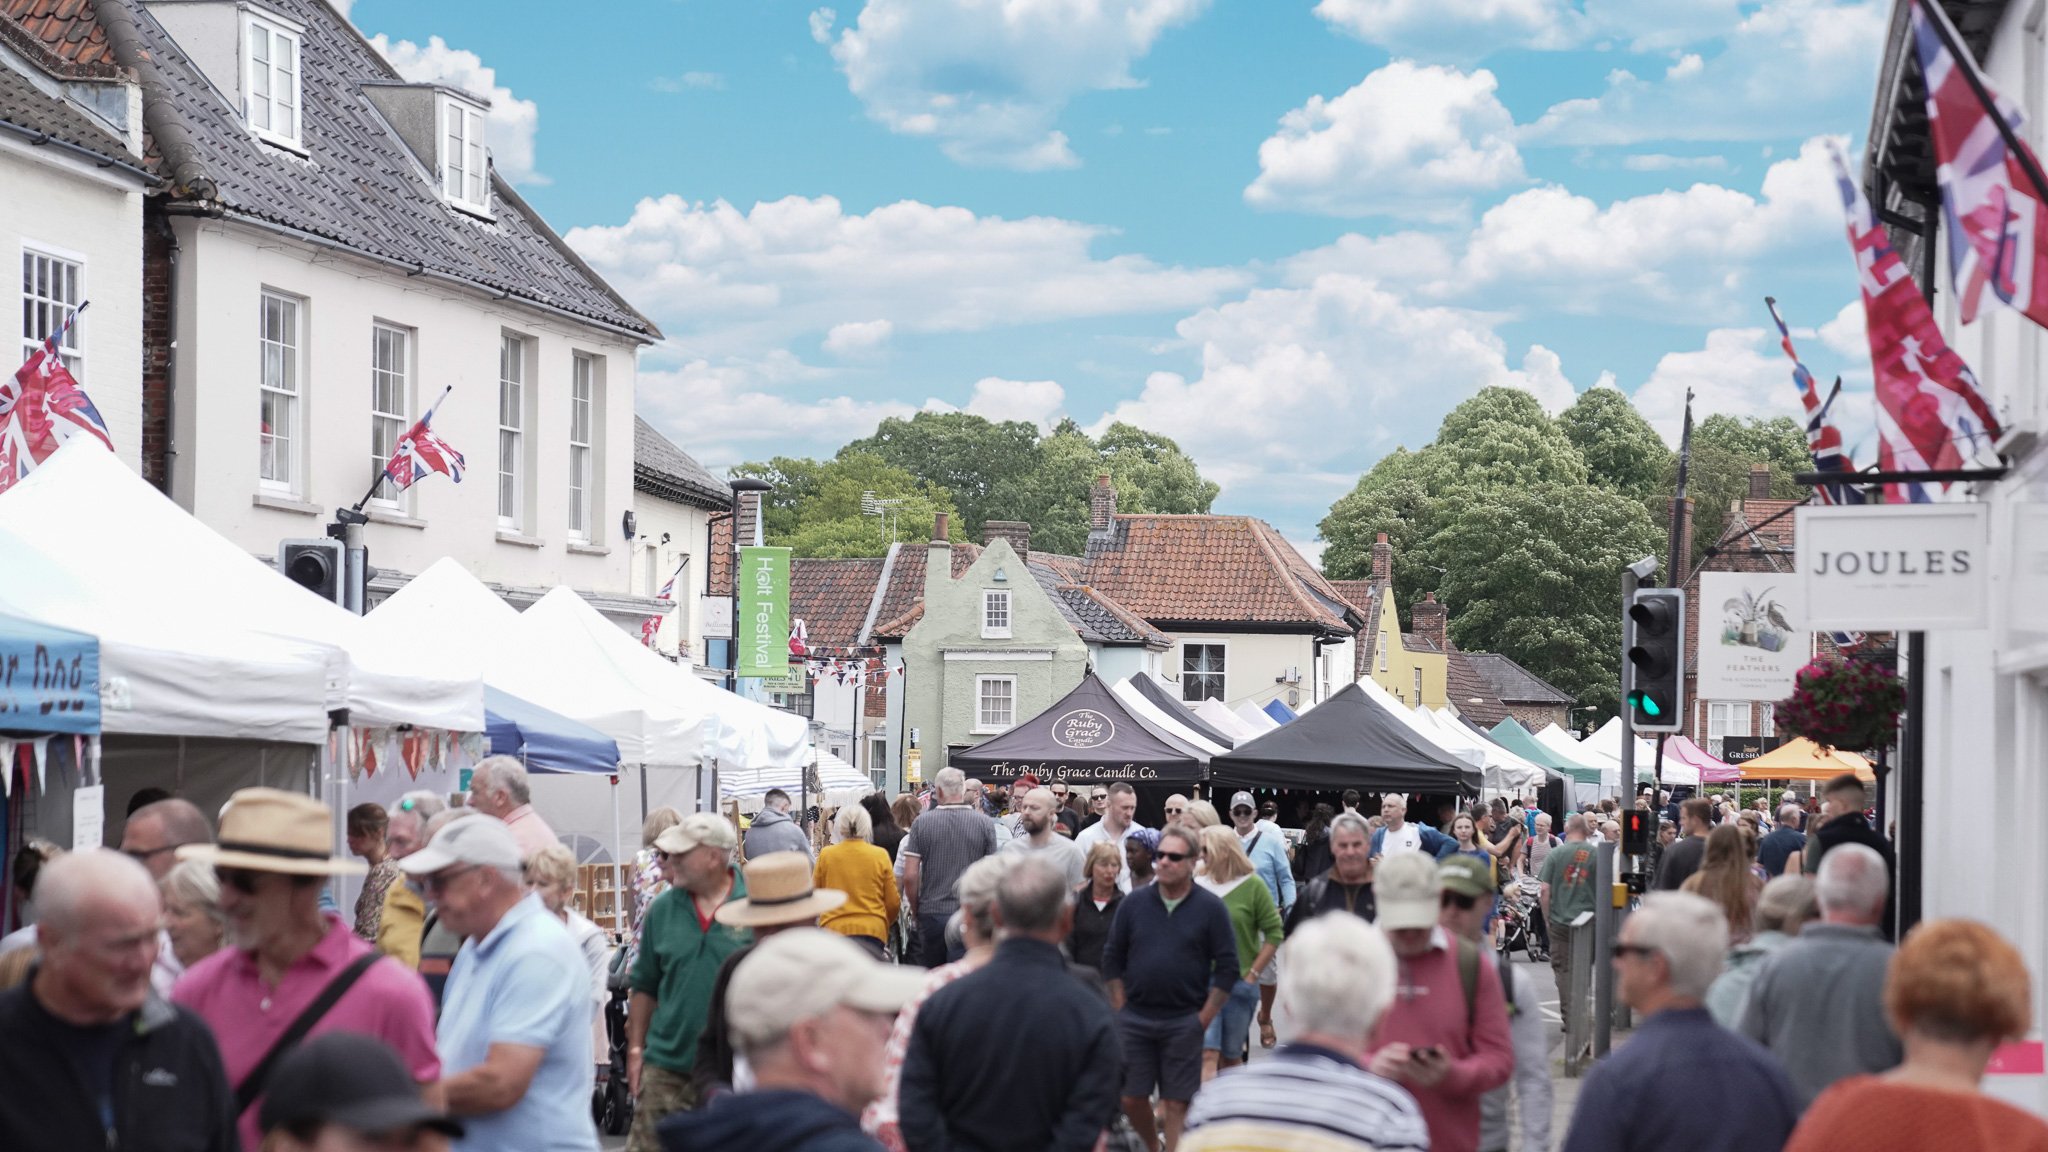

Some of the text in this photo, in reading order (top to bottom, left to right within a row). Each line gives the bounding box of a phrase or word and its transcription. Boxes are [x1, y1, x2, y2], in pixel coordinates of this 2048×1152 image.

[1814, 550, 1970, 575] JOULES
[755, 602, 773, 668] Festival
[1726, 664, 1781, 672] FEATHERS
[1064, 728, 1101, 739] Grace
[1066, 718, 1103, 732] Ruby
[990, 762, 1158, 782] The Ruby Grace Candle Co.
